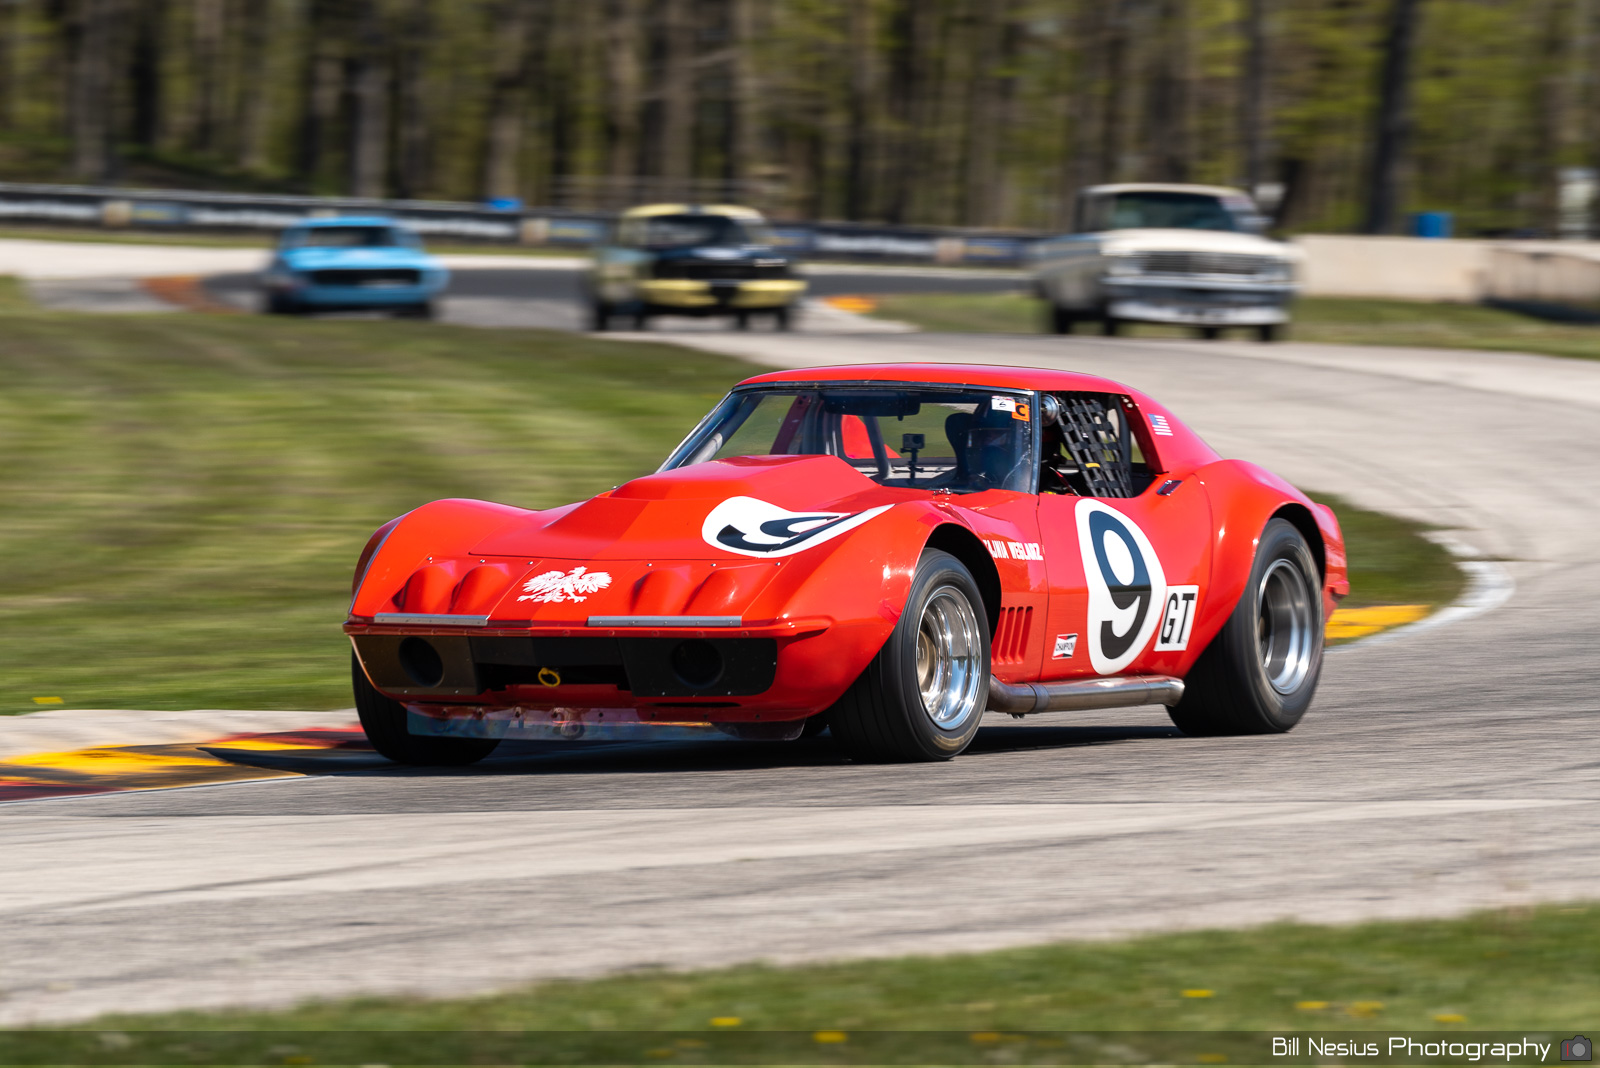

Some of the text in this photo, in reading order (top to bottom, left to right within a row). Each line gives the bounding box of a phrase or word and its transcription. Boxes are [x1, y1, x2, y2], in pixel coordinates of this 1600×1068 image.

[1015, 404, 1025, 416] C
[1089, 510, 1151, 659] 9
[1161, 592, 1195, 644] GT
